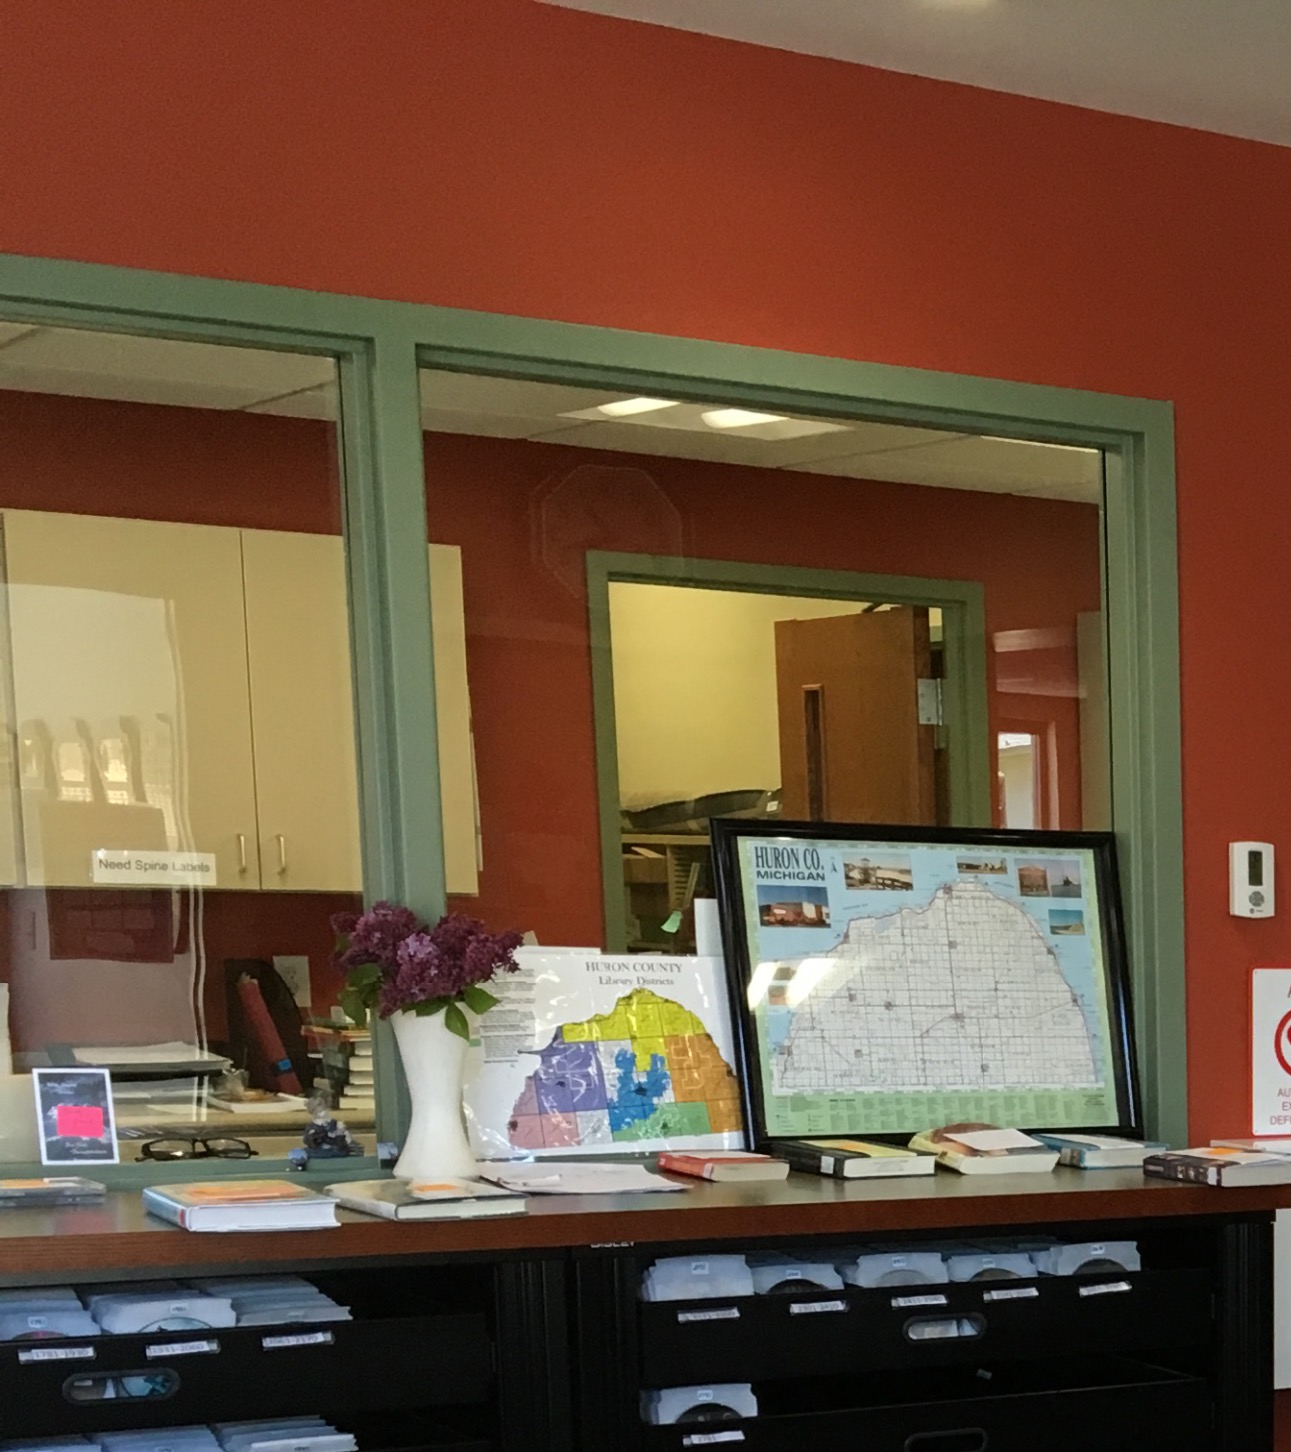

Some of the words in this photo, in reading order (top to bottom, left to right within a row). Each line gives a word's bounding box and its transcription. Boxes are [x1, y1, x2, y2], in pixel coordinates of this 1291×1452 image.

[754, 846, 800, 869] HURON
[803, 848, 824, 870] CO.
[99, 859, 131, 870] Need
[135, 860, 168, 872] Spine
[172, 862, 211, 872] Labels
[756, 871, 825, 881] MICHIGAN
[585, 962, 630, 972] HURON
[632, 962, 682, 973] COUNTY
[599, 976, 633, 985] Library
[636, 976, 675, 985] Districts
